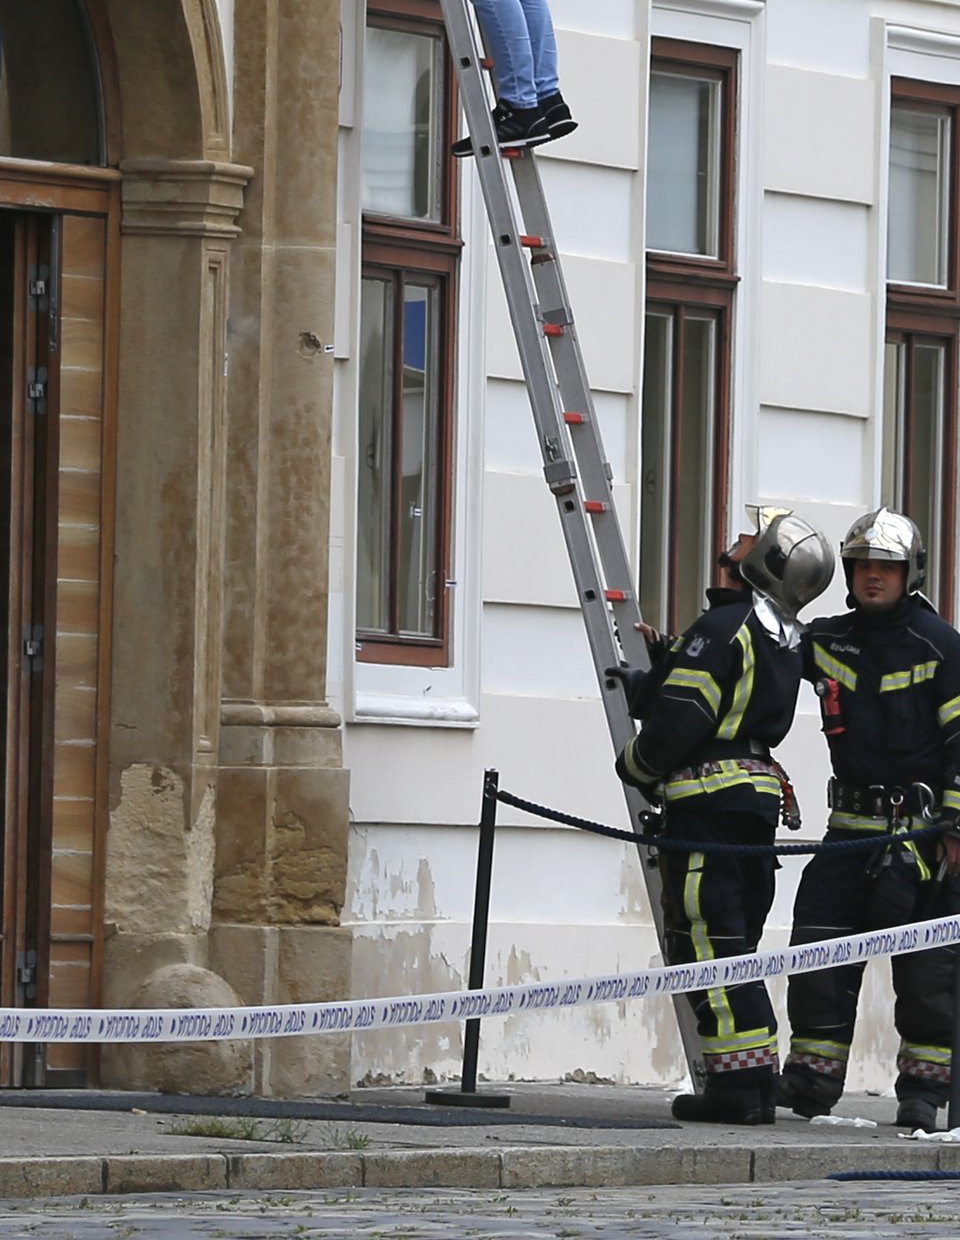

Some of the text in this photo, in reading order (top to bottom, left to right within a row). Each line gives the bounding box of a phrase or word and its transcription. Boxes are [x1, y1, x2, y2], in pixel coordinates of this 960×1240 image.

[864, 936, 897, 958] POLICIJA
[897, 931, 919, 951] STOP
[764, 955, 785, 976] STOP
[797, 949, 830, 971] POLICIJA
[831, 945, 852, 965] STOP
[662, 969, 695, 991] POLICIJA
[696, 965, 718, 986] STOP
[729, 959, 763, 981] POLICIJA
[560, 984, 582, 1005] STOP
[594, 979, 628, 1000] POLICIJA
[628, 975, 650, 995] STOP
[457, 996, 491, 1018] POLICIJA
[492, 993, 514, 1013] STOP
[527, 988, 560, 1009] POLICIJA
[319, 1007, 352, 1028] POLICIJA
[355, 1006, 375, 1026] STOP
[389, 1004, 422, 1024] POLICIJA
[423, 1000, 445, 1020] STOP
[33, 1016, 69, 1037] POLICIJA
[70, 1016, 92, 1038] STOP
[105, 1016, 140, 1038] POLICIJA
[142, 1016, 164, 1038] STOP
[177, 1015, 212, 1036] POLICIJA
[214, 1014, 235, 1037] STOP
[248, 1012, 284, 1034] POLICIJA
[284, 1011, 307, 1032] STOP
